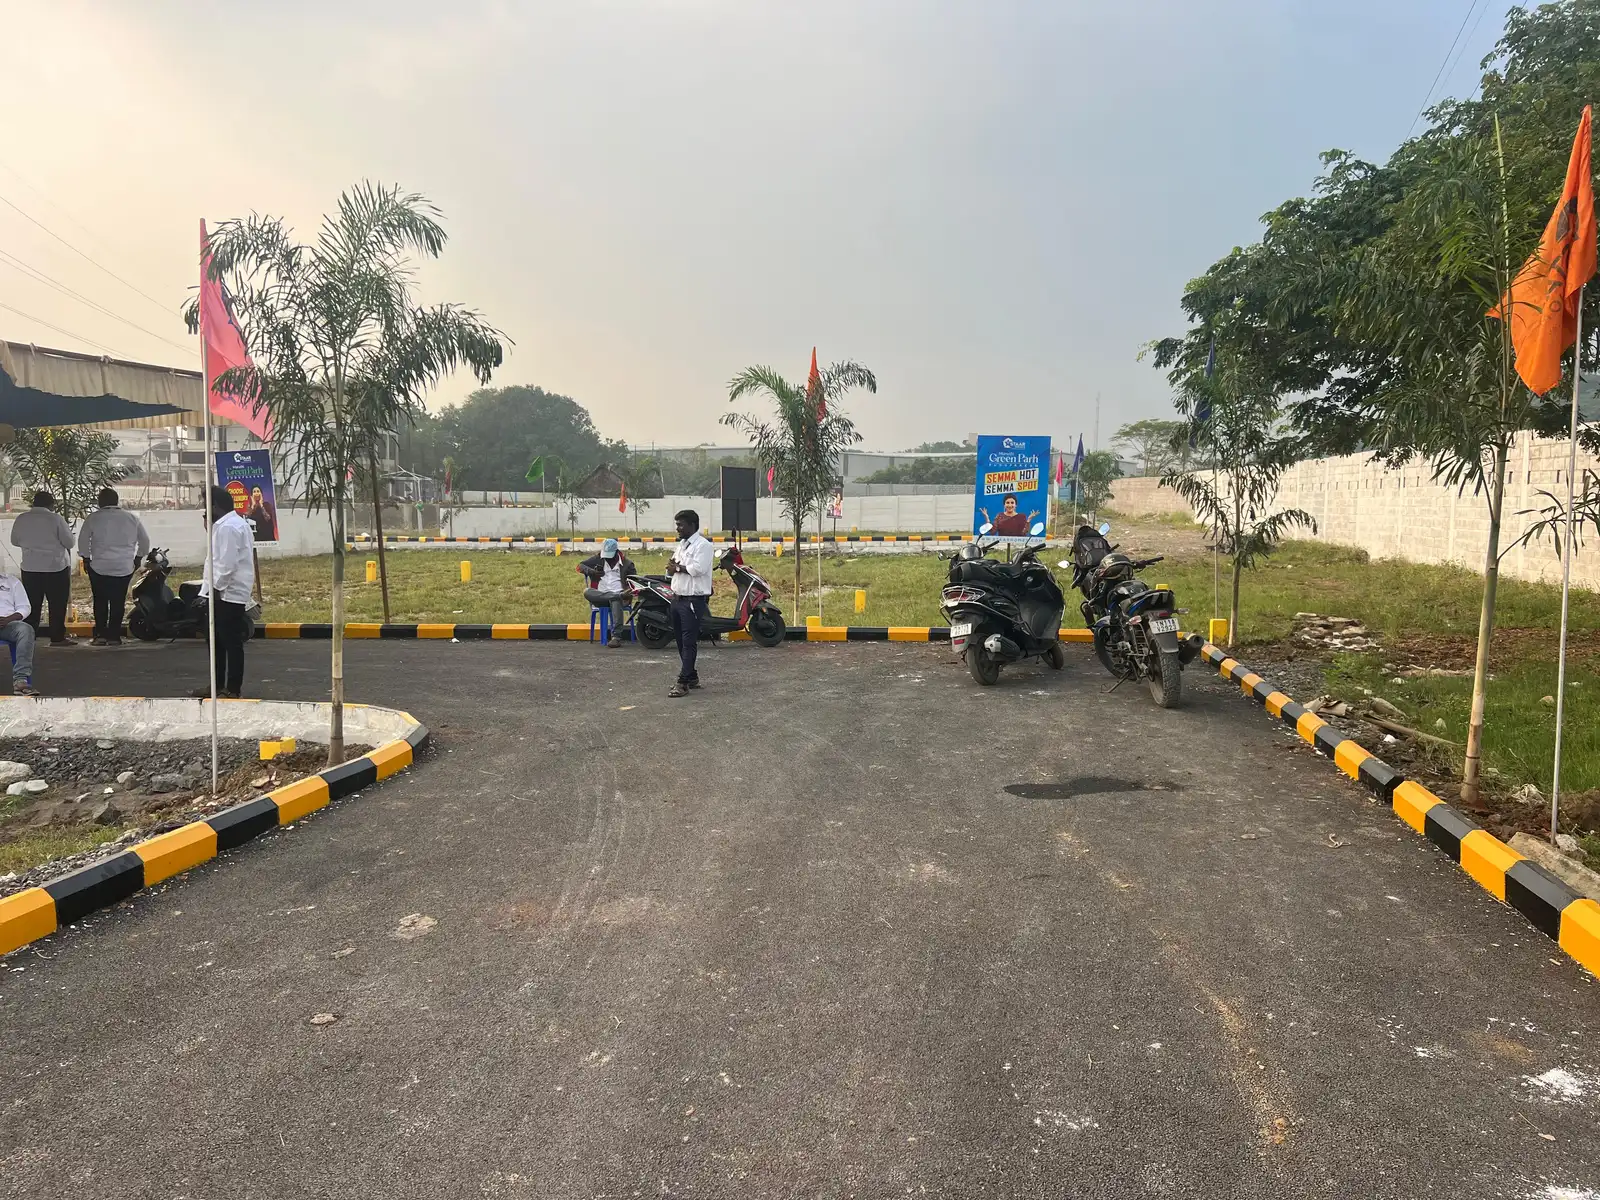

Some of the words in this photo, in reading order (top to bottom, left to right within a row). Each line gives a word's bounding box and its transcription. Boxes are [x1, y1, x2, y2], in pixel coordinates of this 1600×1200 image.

[989, 453, 1016, 462] Green
[986, 471, 1017, 484] SEMMA
[1019, 469, 1037, 480] HOT
[986, 483, 1015, 494] SEMMA
[1017, 480, 1038, 491] SPOT
